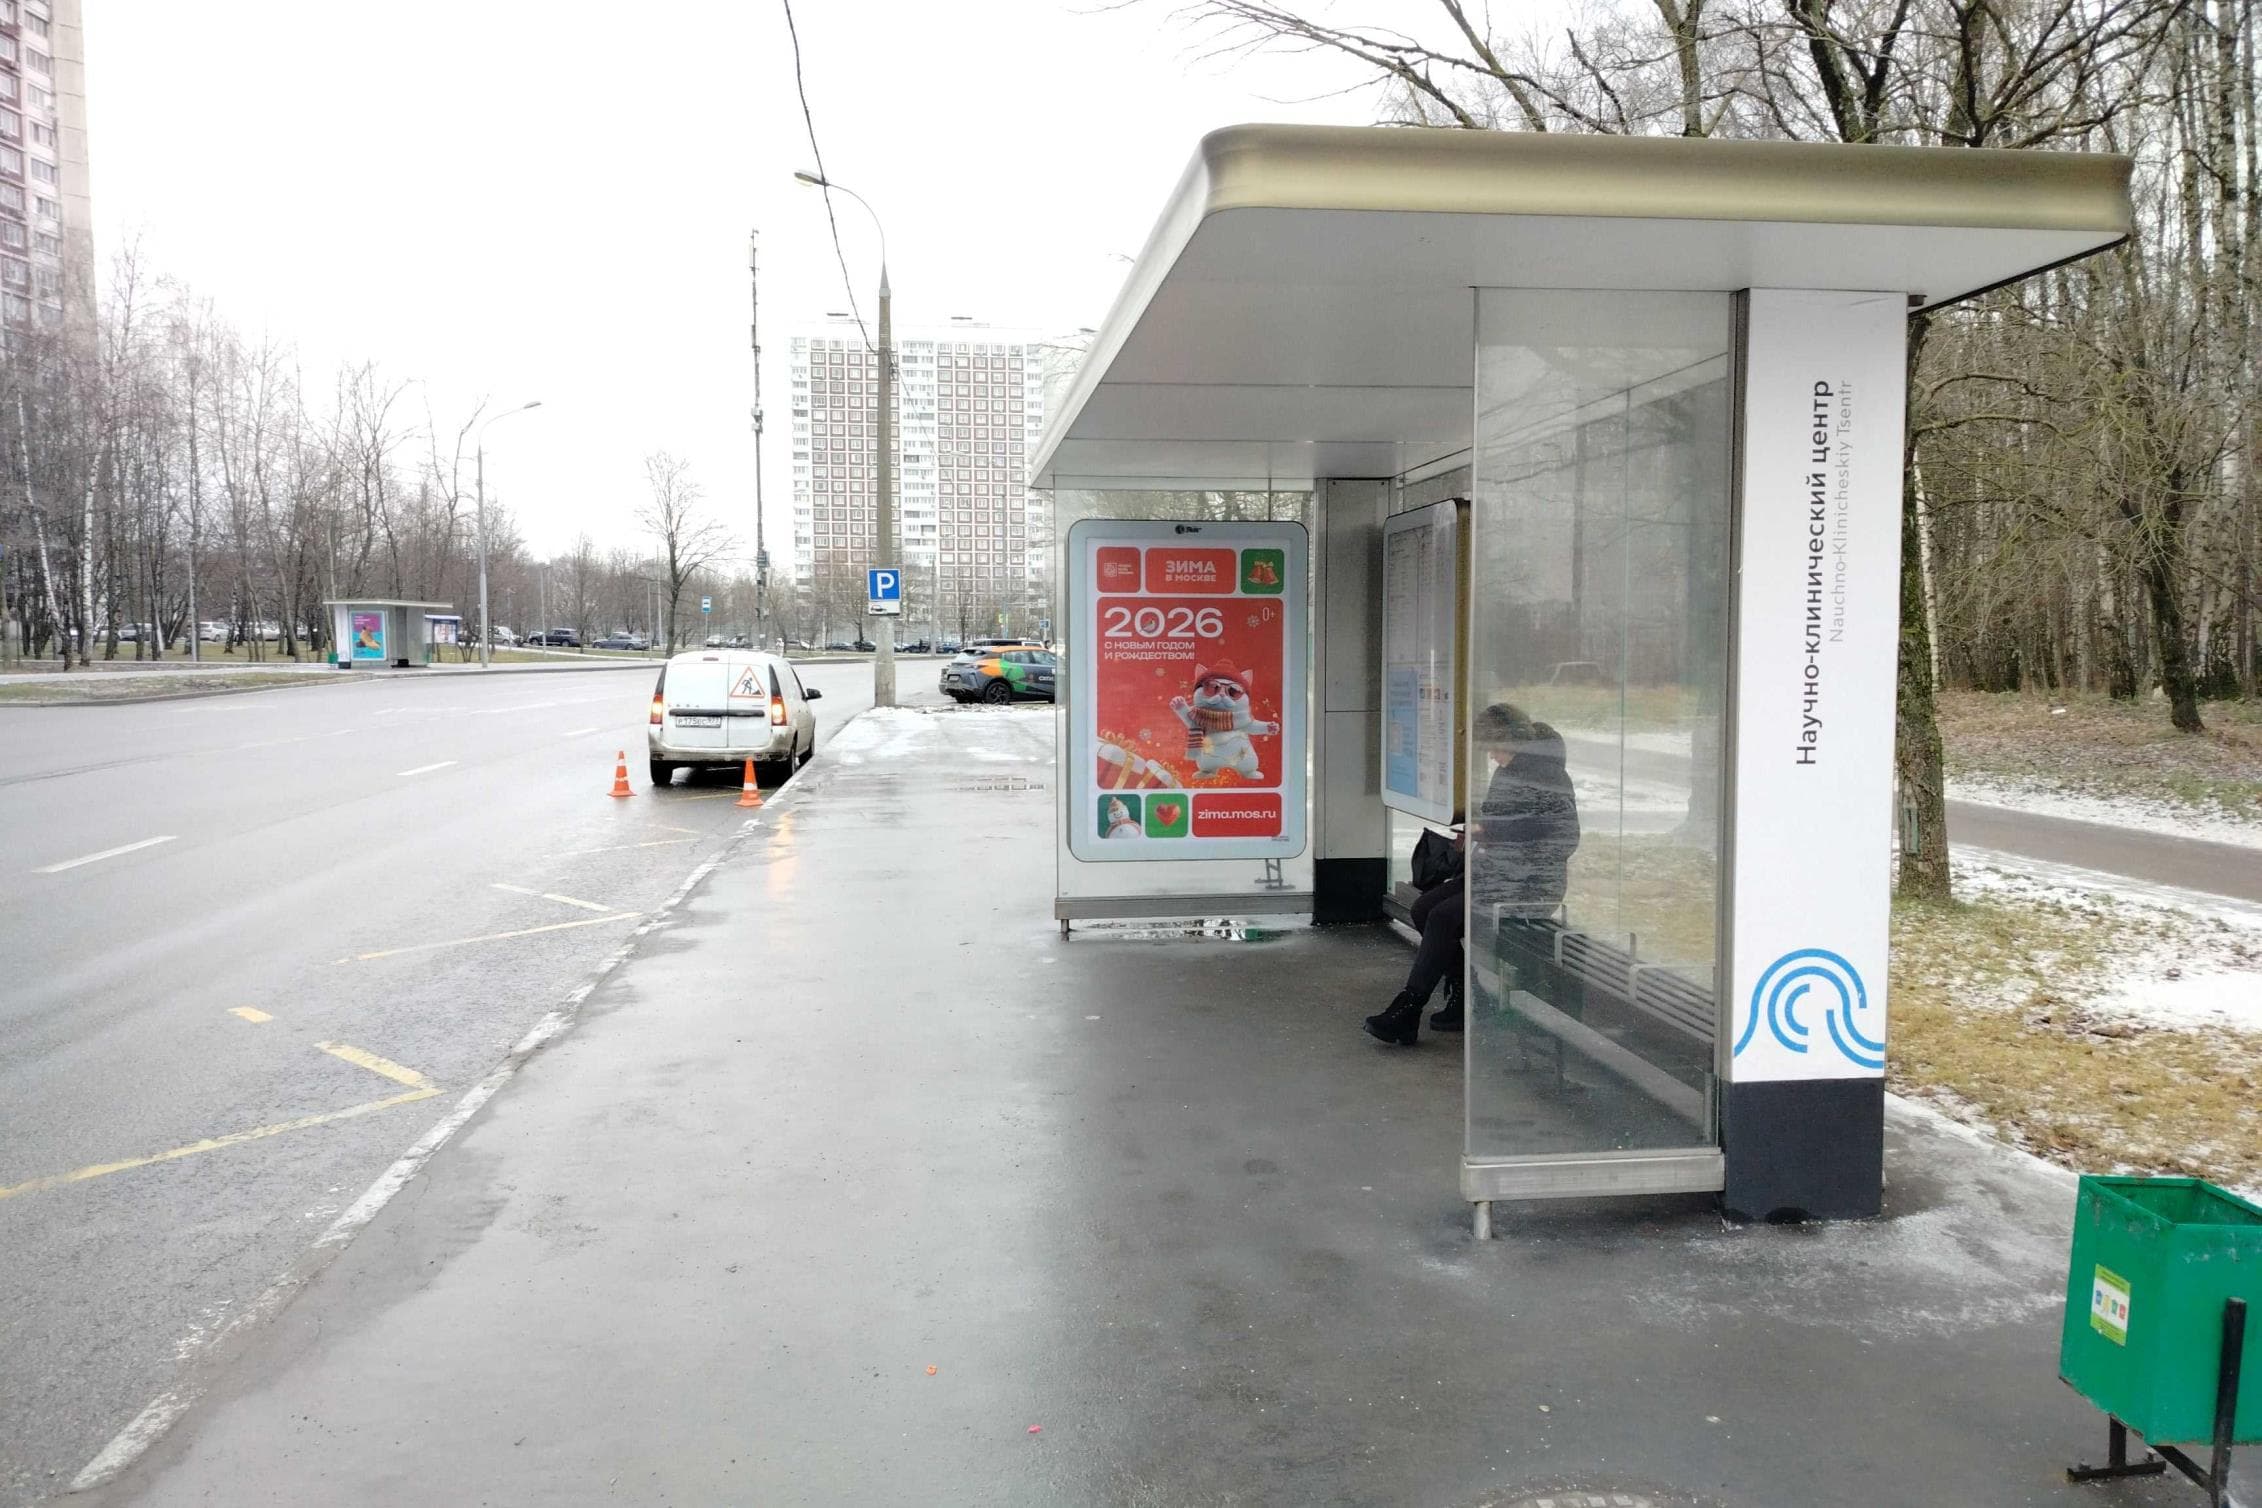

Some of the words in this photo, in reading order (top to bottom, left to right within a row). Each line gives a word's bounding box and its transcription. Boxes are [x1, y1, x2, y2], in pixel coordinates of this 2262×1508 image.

[1836, 379, 1852, 437] Tsentr
[1829, 441, 1853, 643] Nauchno-Klinicheskiy
[1165, 560, 1217, 574] ЗИМА
[1796, 473, 1827, 765] Научно-клинический
[1812, 380, 1834, 463] центр
[877, 572, 895, 598] P
[1165, 574, 1173, 582] В
[1175, 574, 1217, 582] МОСКВЕ
[1262, 606, 1276, 622] 0+
[1104, 606, 1224, 639] 2026
[1104, 641, 1112, 649] С
[1114, 641, 1155, 650] НОВЫМ
[1157, 641, 1195, 650] ГОДОМ
[1104, 651, 1113, 660] И
[1115, 651, 1195, 660] РОЖДЕСТВОМ!
[1198, 808, 1277, 819] zima.mos.ru
